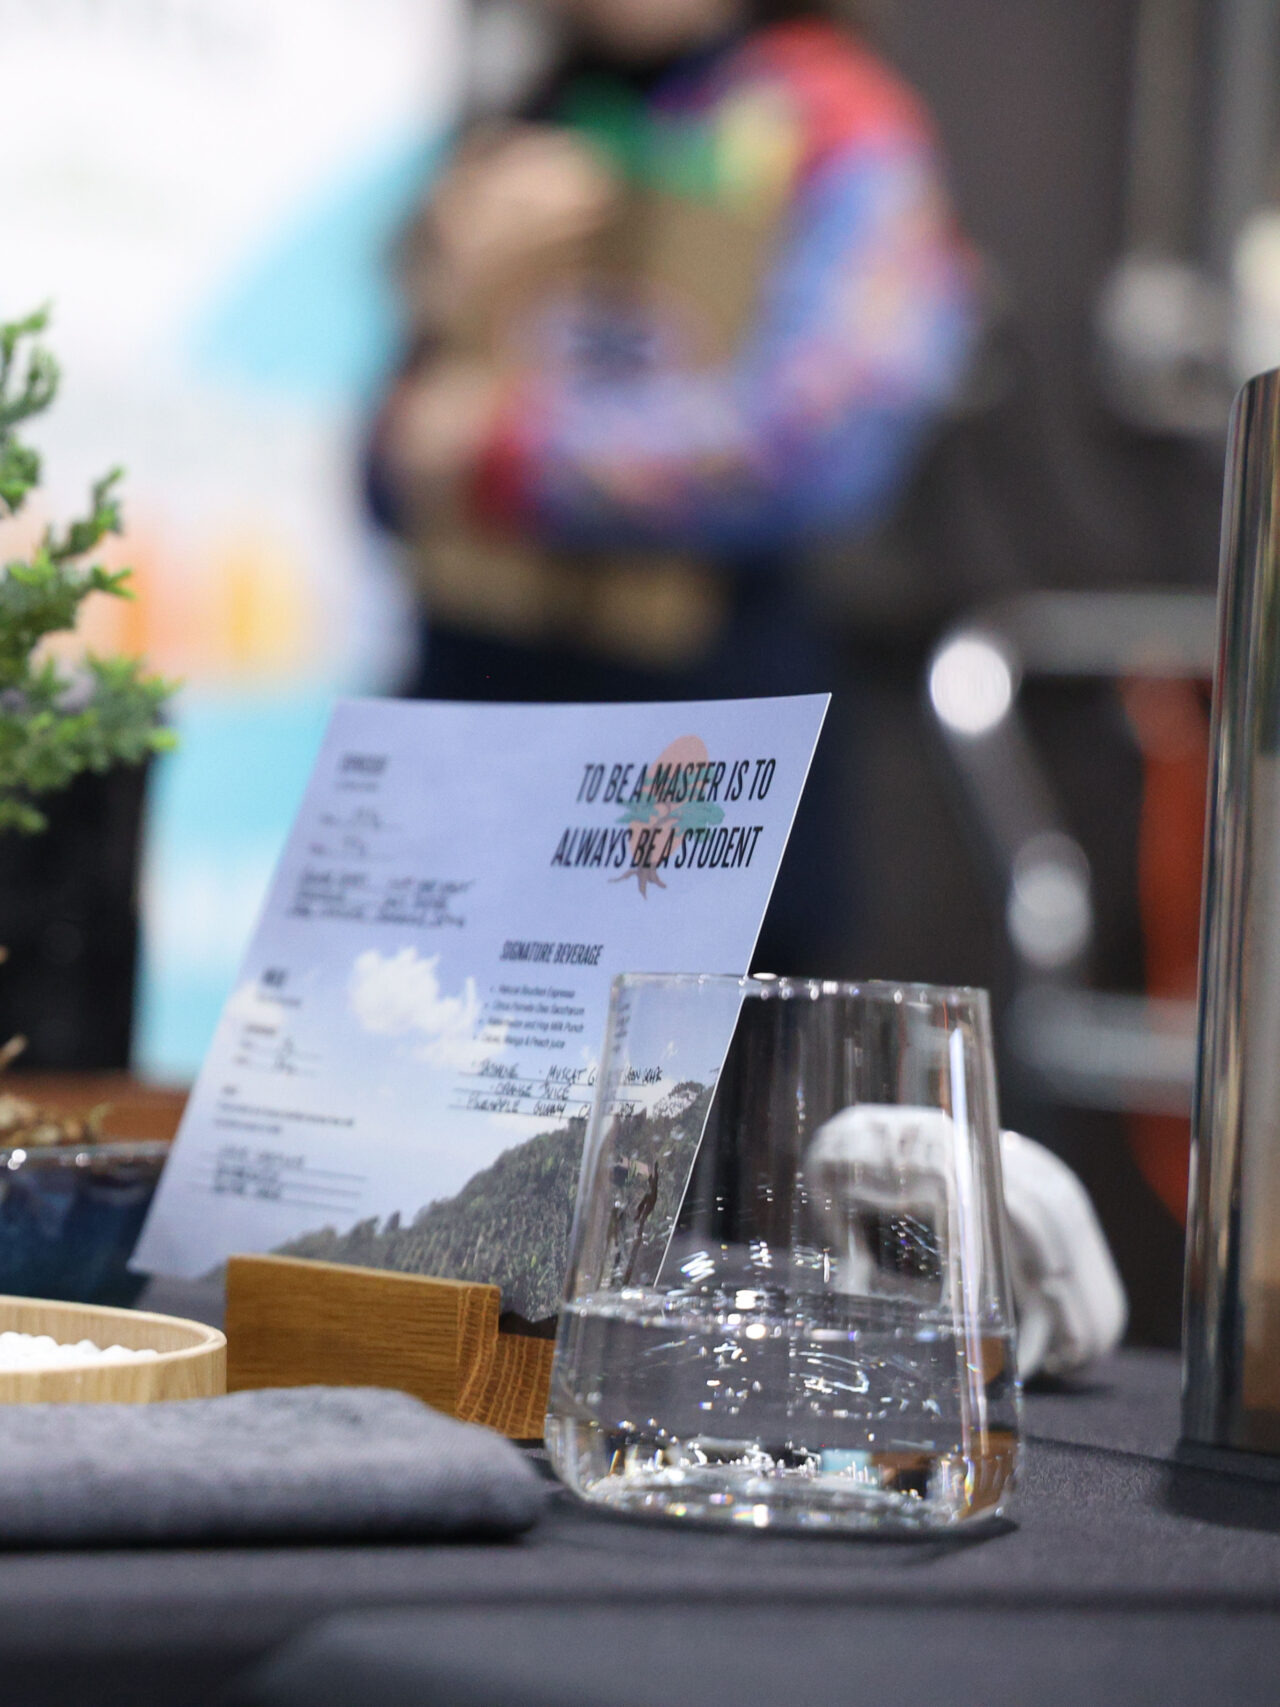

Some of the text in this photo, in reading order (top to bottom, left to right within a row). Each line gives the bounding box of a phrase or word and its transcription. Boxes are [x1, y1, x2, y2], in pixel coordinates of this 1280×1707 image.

[577, 758, 777, 803] TO BE A MASTER IS TO
[551, 827, 764, 869] ALWAYS BE A STUDENT
[500, 941, 604, 966] SIGNATURE BEVERAGE
